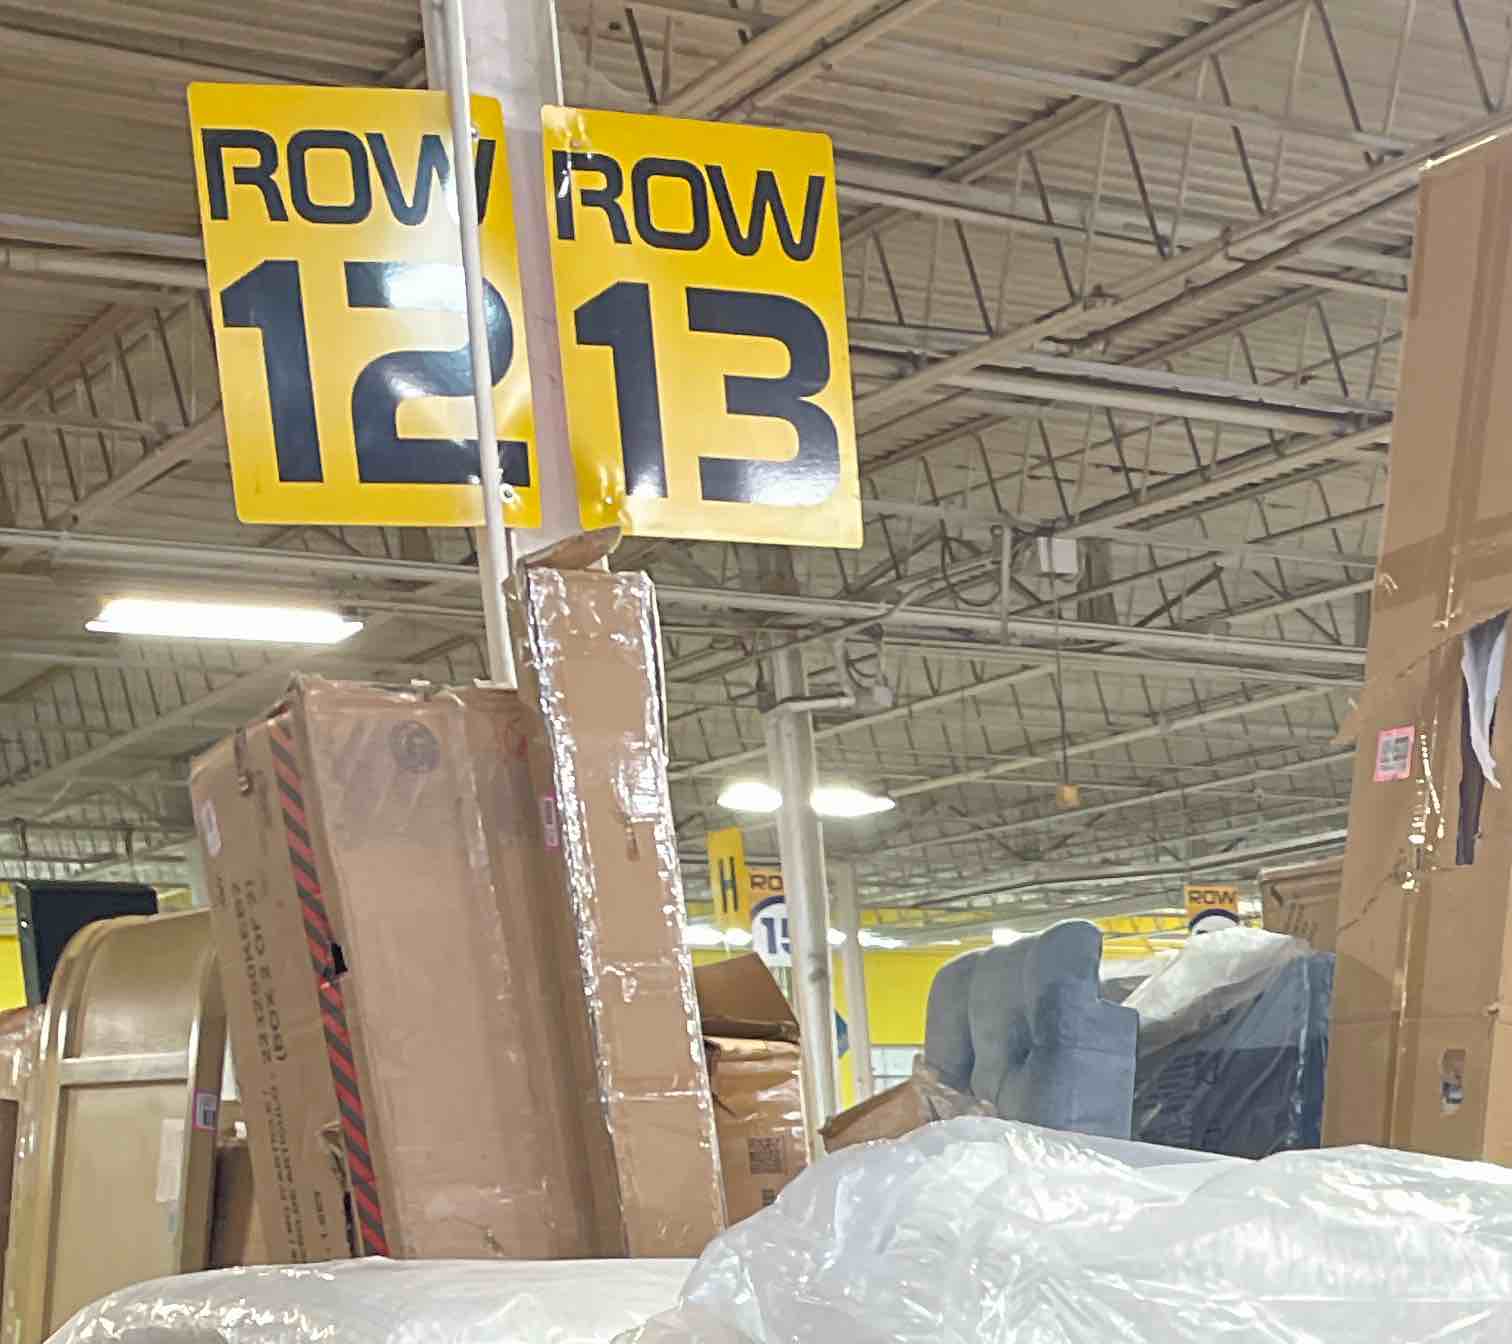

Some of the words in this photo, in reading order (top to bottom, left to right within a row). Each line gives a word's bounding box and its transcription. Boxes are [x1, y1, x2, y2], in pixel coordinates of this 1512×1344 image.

[202, 128, 495, 226] ROW
[551, 150, 824, 261] ROW
[221, 259, 531, 483] 12
[574, 281, 841, 506] 13
[751, 875, 784, 890] RO
[1188, 890, 1233, 904] ROW
